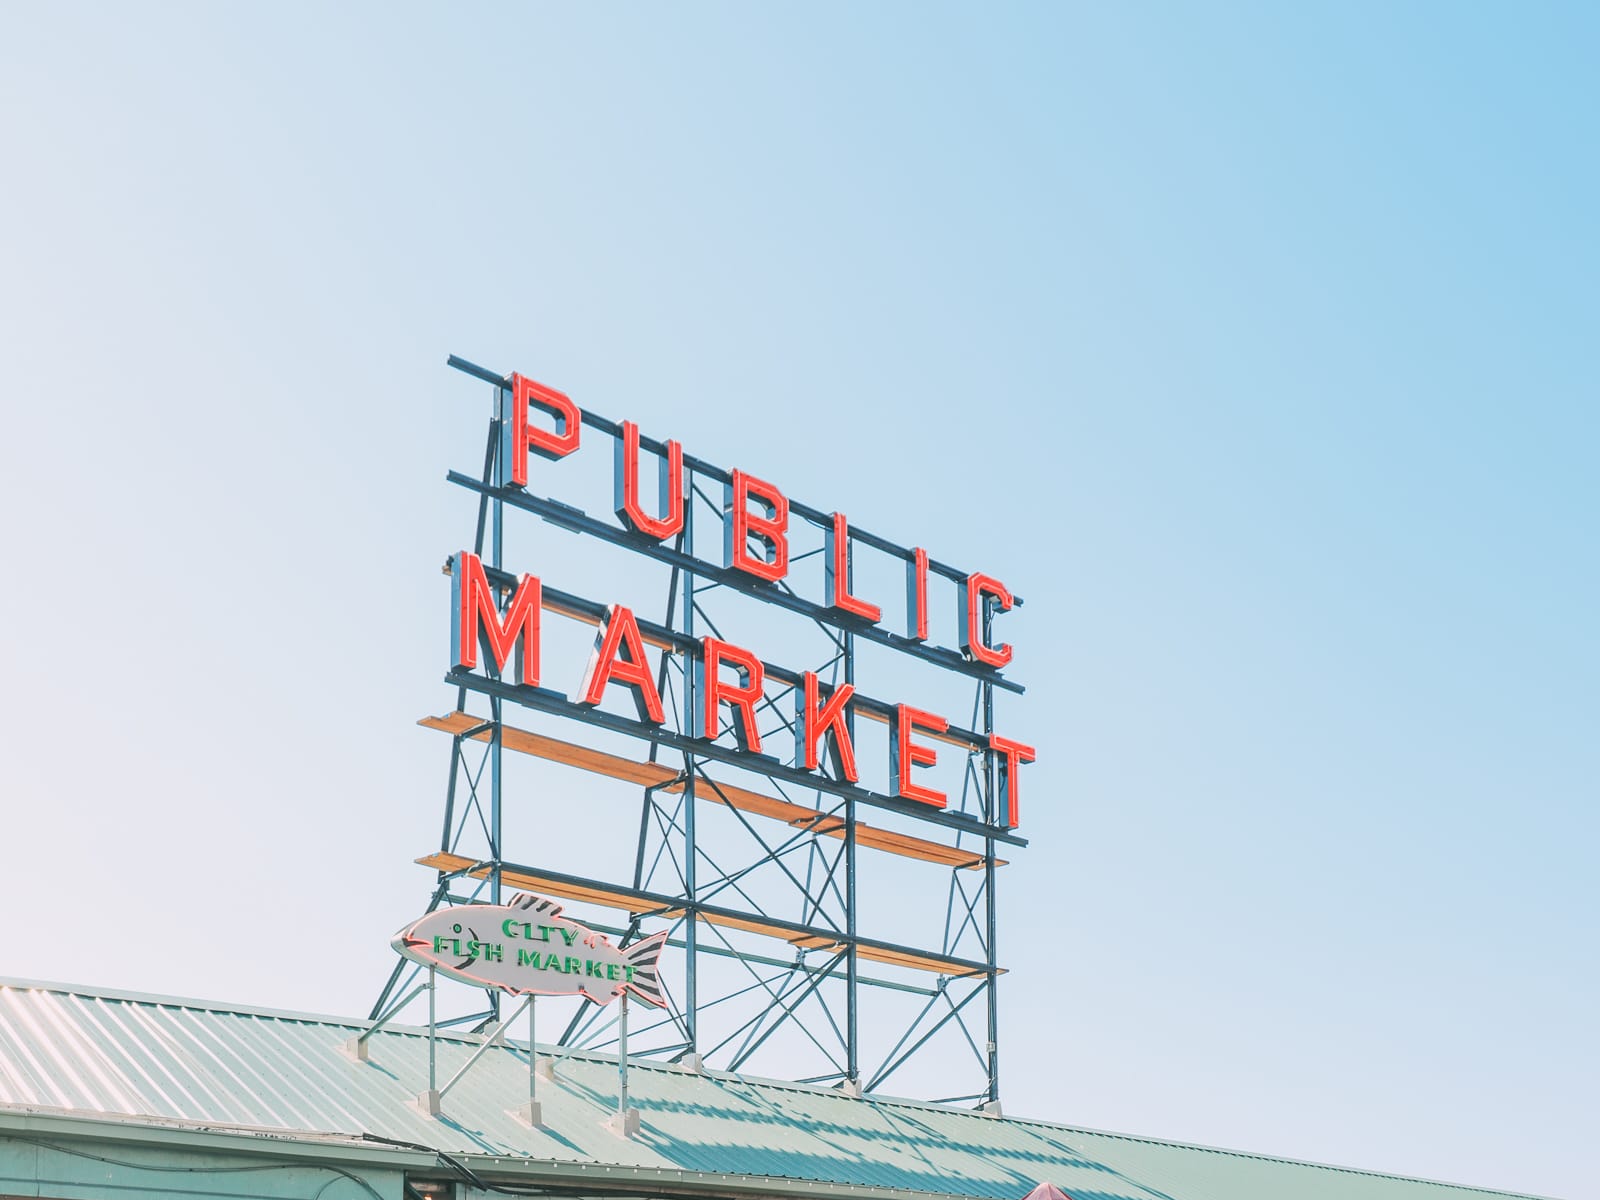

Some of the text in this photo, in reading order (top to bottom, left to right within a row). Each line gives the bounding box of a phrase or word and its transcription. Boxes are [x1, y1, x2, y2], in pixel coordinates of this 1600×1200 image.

[505, 371, 1014, 669] PUBLIC
[452, 550, 1036, 829] MARKET
[433, 935, 638, 984] FISH MARKET
[502, 918, 579, 947] CITY
